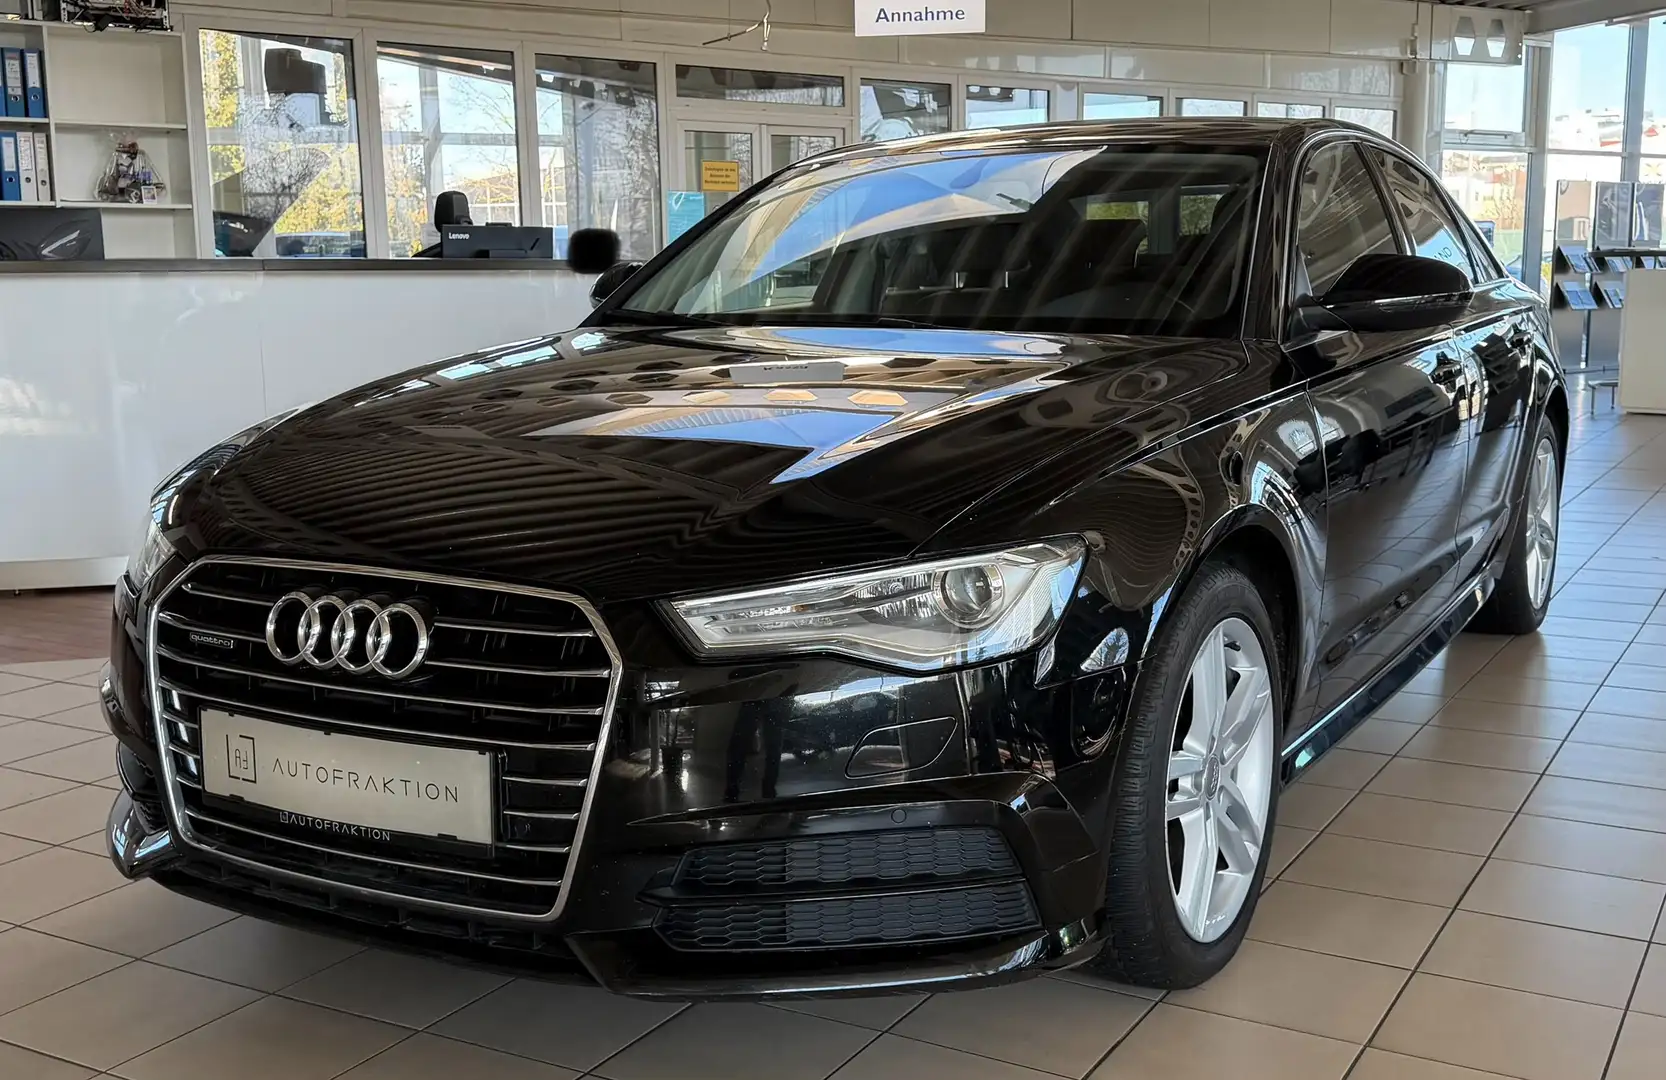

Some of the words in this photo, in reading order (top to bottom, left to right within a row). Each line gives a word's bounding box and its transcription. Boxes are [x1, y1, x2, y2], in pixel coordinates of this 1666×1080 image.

[875, 6, 966, 23] Annahme
[448, 232, 470, 240] Lenovo
[190, 634, 231, 647] quattro
[272, 757, 458, 803] AUTOFRAKTION
[289, 814, 391, 842] AUTOFRAKTION
